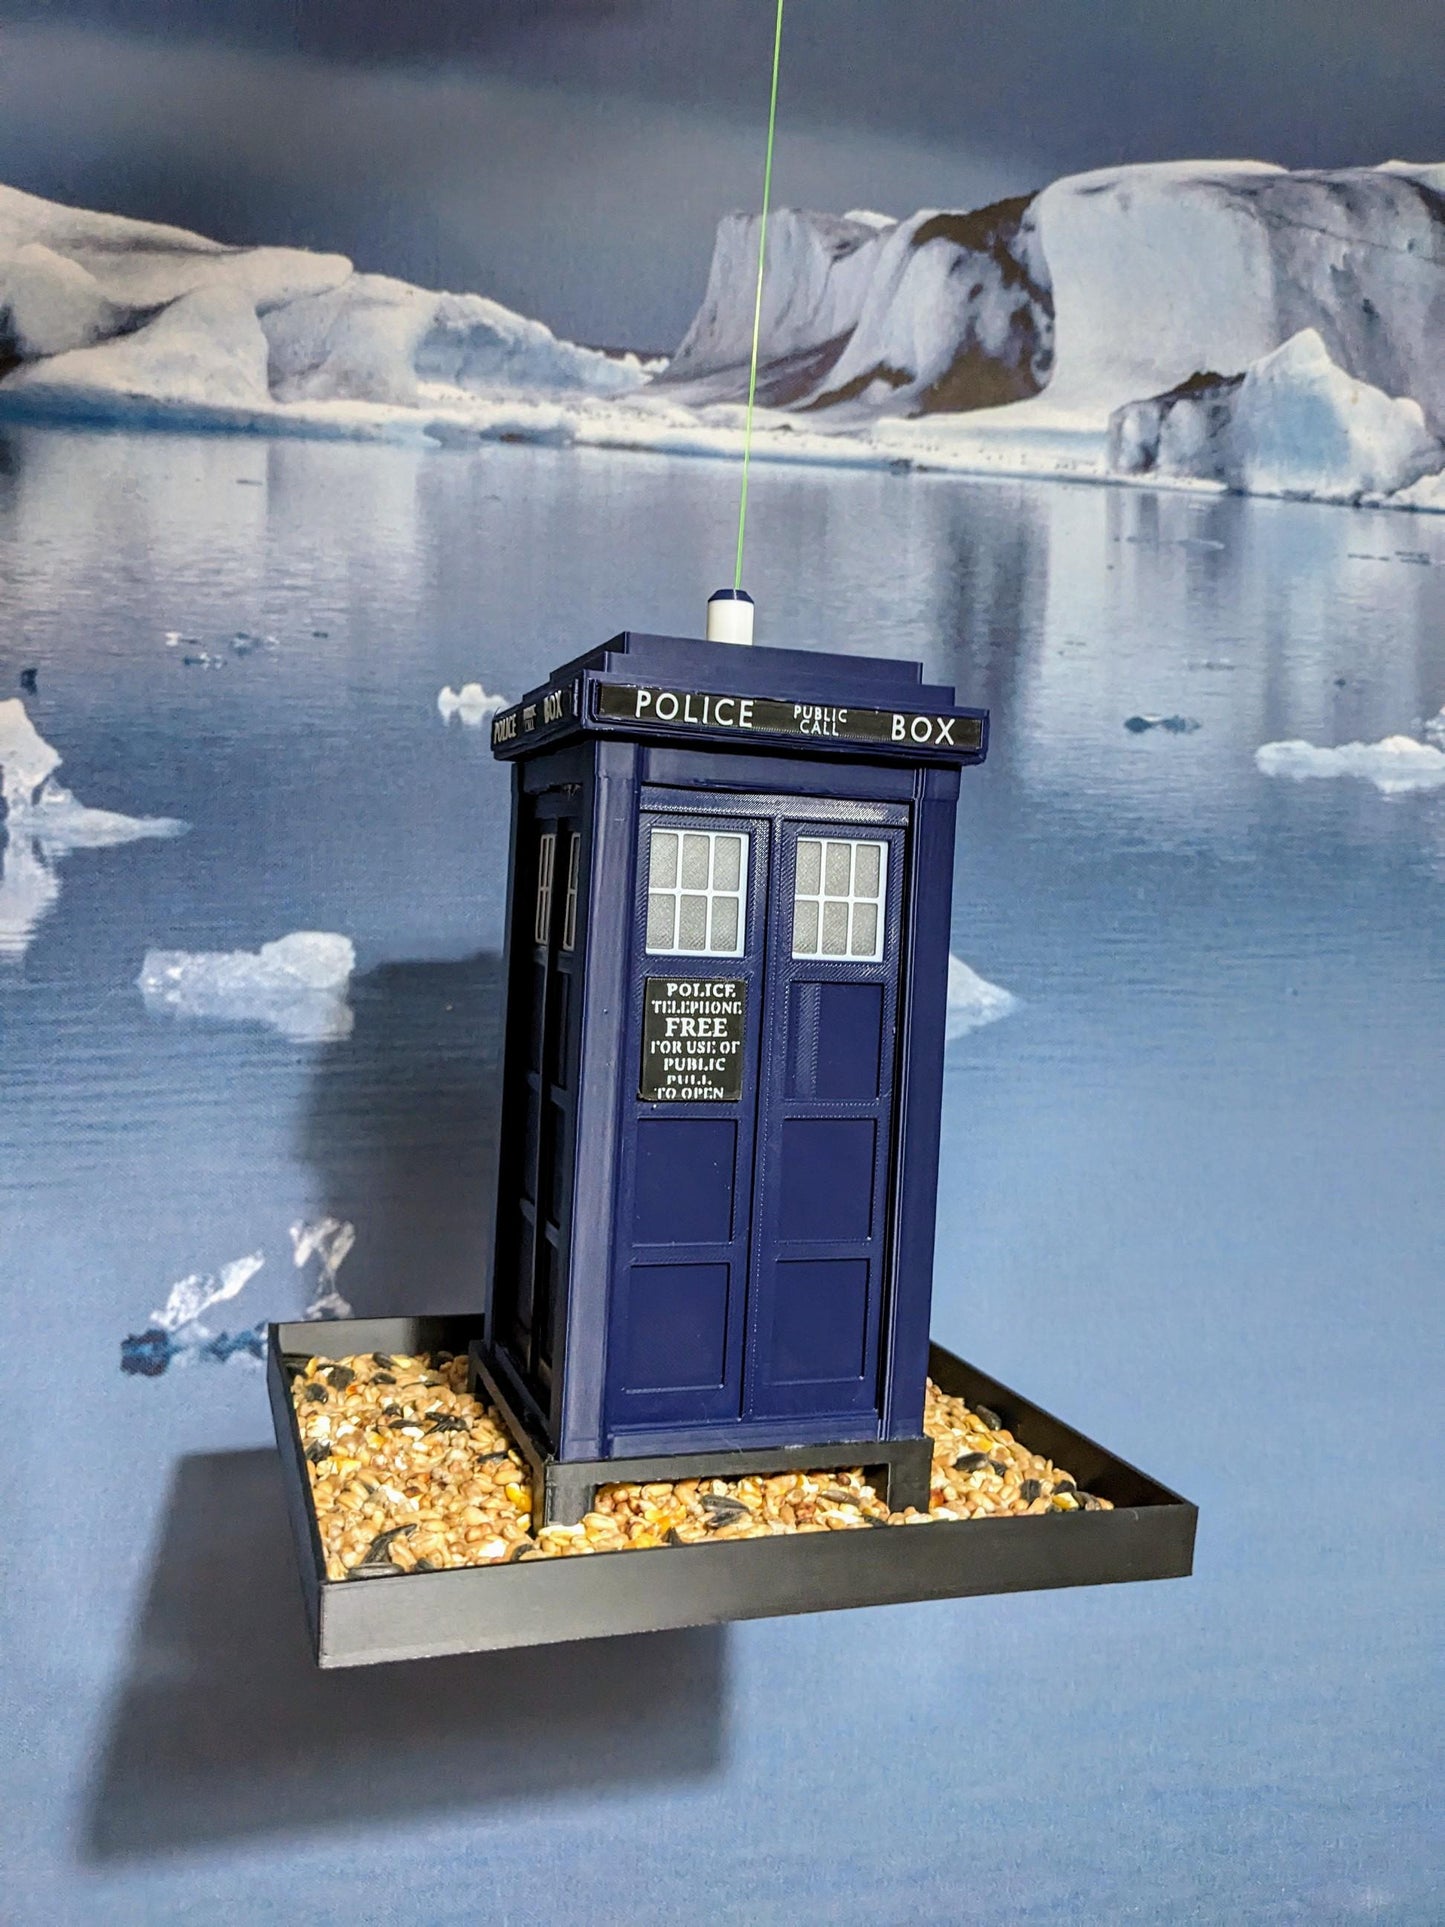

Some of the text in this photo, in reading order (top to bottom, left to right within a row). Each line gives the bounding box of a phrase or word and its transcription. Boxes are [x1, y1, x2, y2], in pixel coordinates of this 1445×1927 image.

[634, 690, 755, 728] POLICE
[793, 705, 848, 724] PUBLIC
[800, 719, 840, 737] CALL
[891, 714, 956, 746] BOX
[666, 983, 736, 998] POLICE
[665, 1017, 728, 1037] FREE
[663, 1057, 726, 1071] PUBLIC
[654, 1087, 724, 1100] TO OPEN
